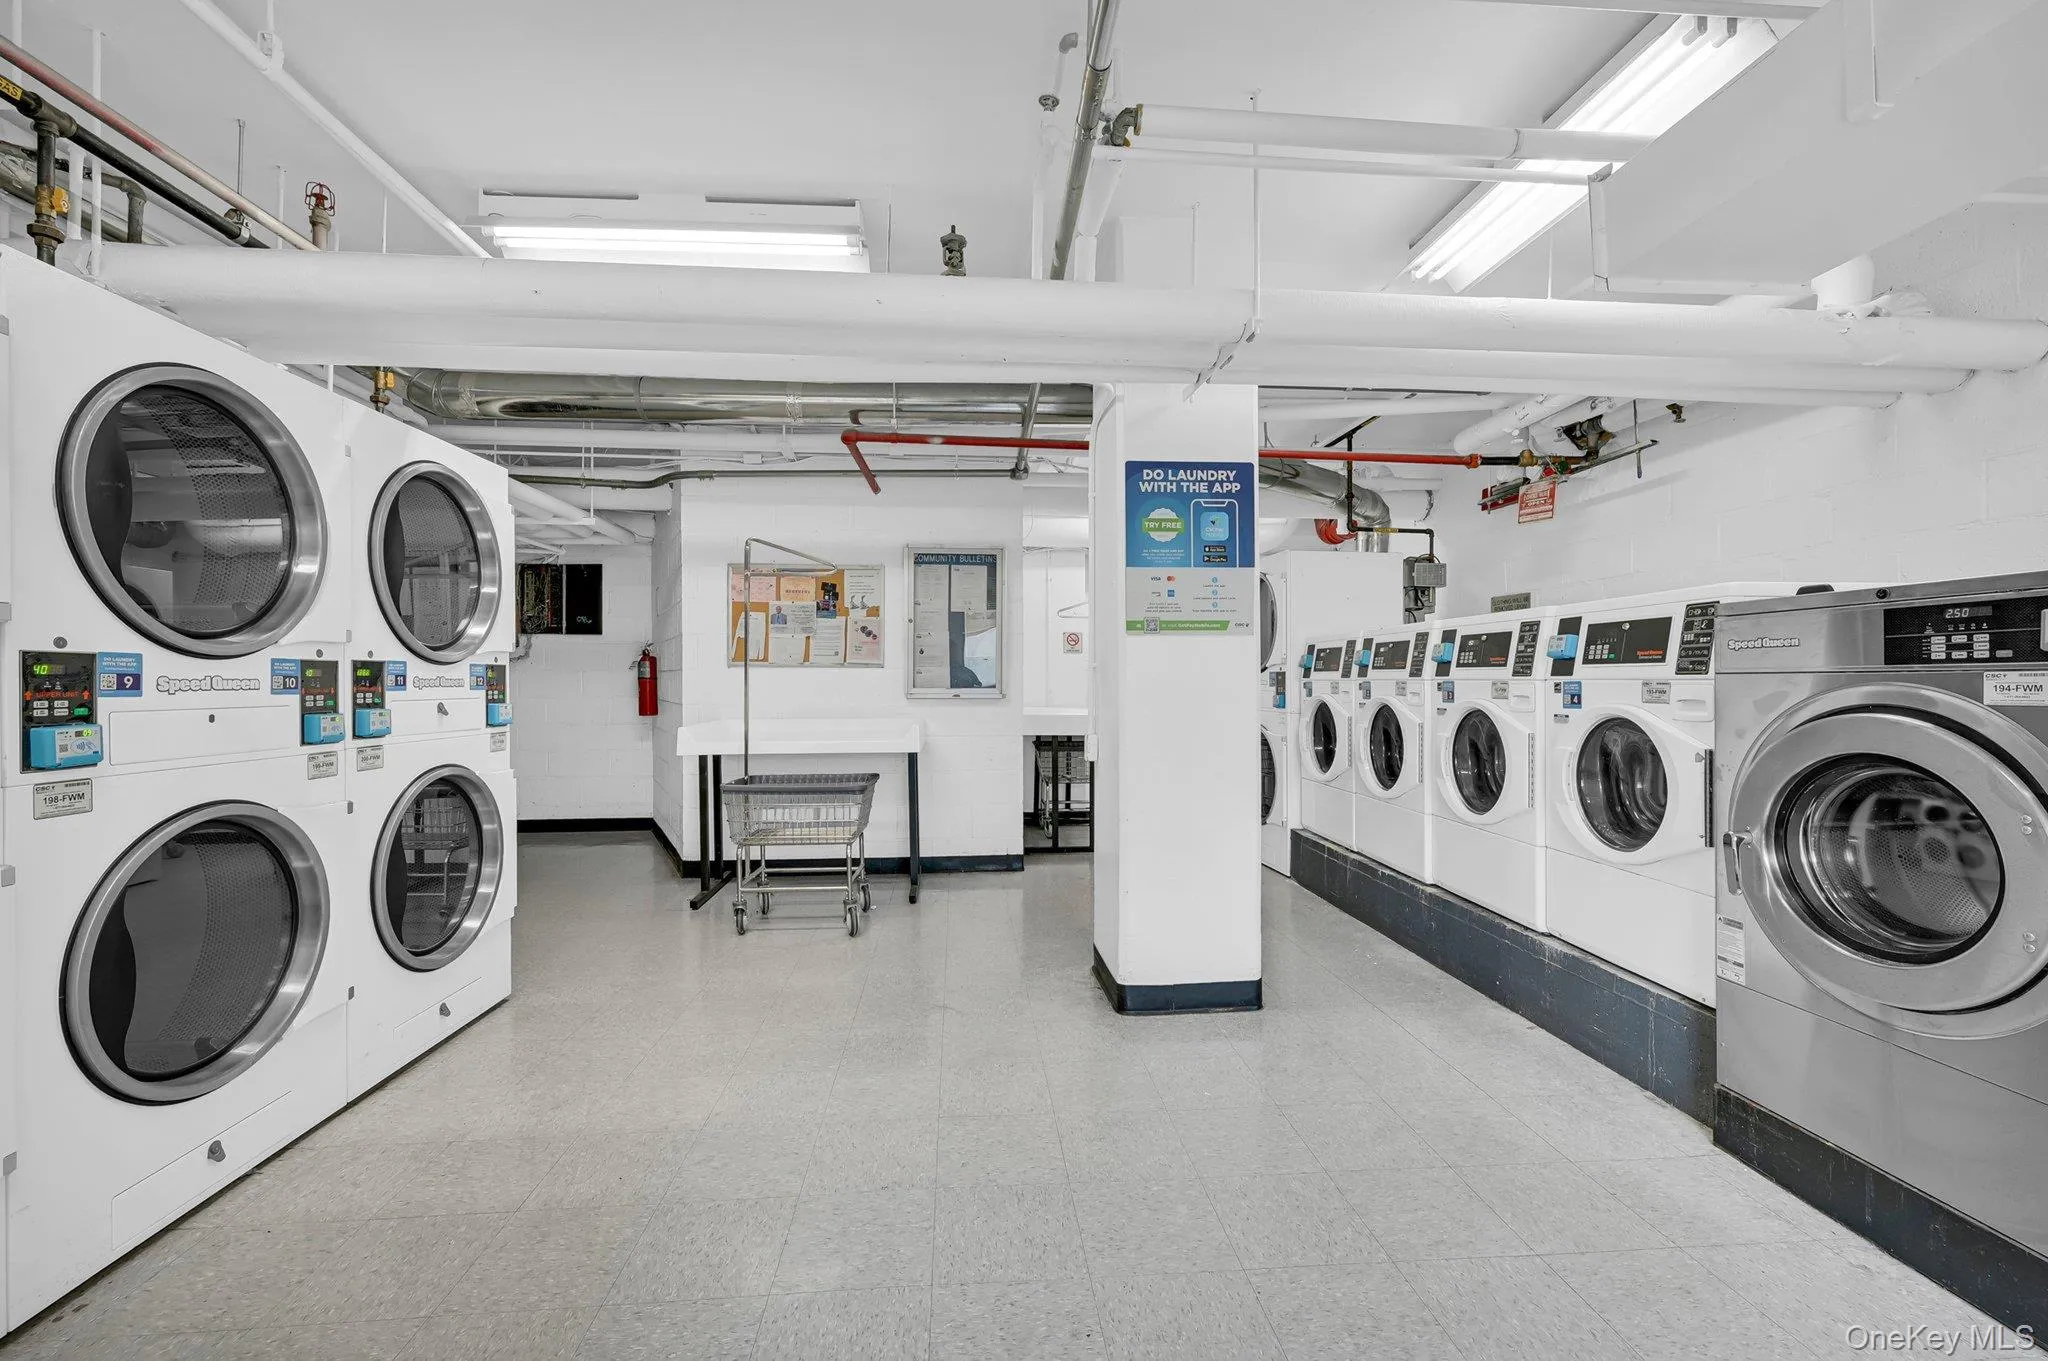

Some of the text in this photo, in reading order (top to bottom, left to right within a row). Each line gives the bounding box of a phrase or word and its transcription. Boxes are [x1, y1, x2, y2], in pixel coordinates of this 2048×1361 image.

[1142, 469, 1236, 481] DO LAUNDRY
[1138, 481, 1241, 493] WITH THE APP
[1144, 521, 1182, 529] TRY FREE
[959, 555, 997, 563] BULLETINS
[1945, 607, 1970, 618] 2.50
[1728, 637, 1800, 650] Speed Queen
[33, 664, 48, 675] 40
[123, 675, 133, 688] 9
[156, 675, 260, 695] Speed Queen
[284, 678, 296, 688] 10
[397, 676, 404, 685] 11
[413, 676, 465, 690] Speed Queen
[476, 676, 484, 685] 12
[1993, 684, 2043, 692] 194-FWM
[1573, 695, 1579, 703] 4
[43, 792, 85, 805] 198-FWM
